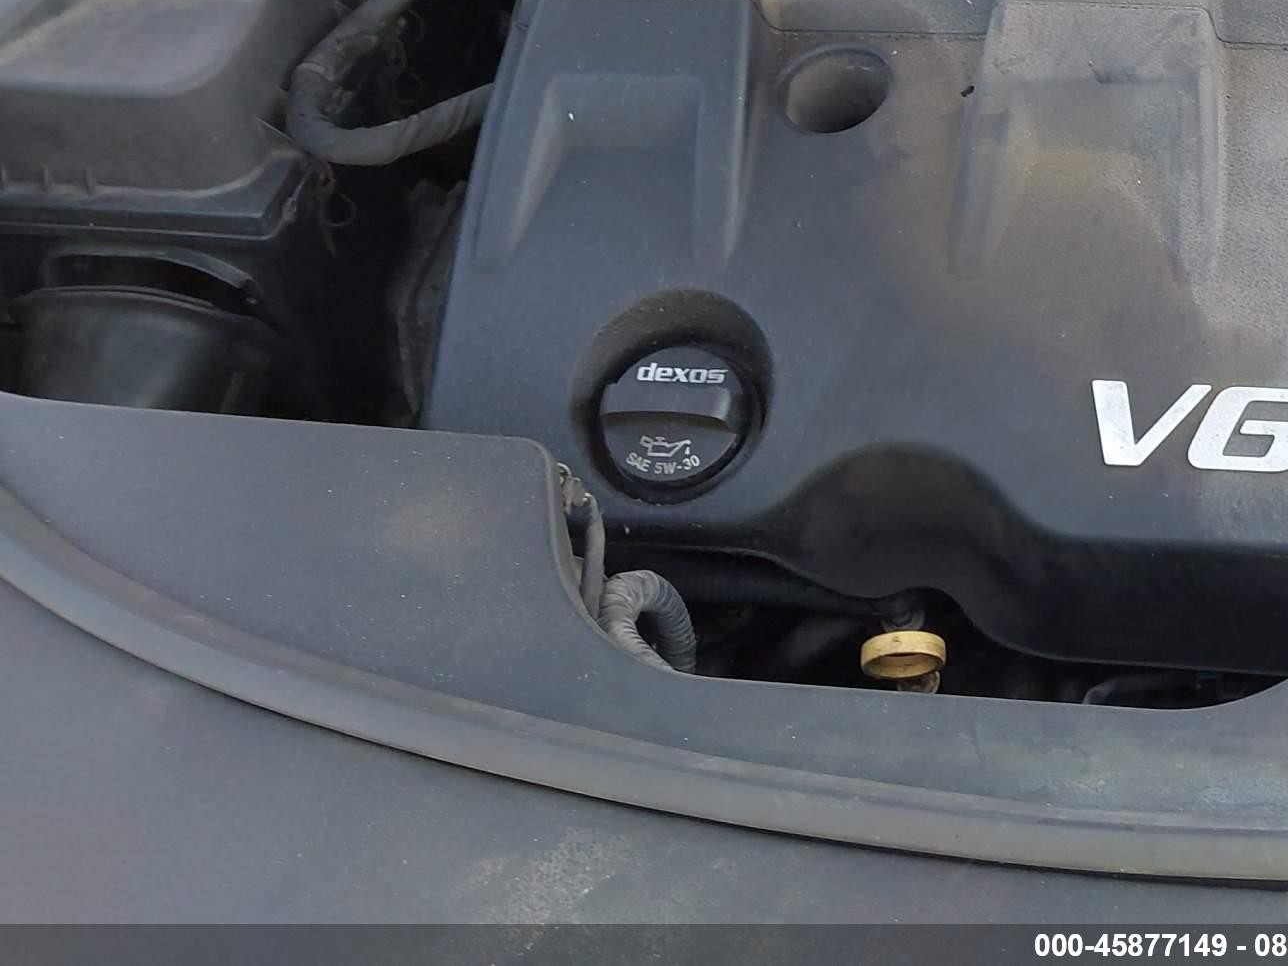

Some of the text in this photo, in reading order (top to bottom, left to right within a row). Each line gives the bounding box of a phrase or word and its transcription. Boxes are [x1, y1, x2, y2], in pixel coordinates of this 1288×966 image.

[636, 362, 728, 384] dexos
[625, 452, 701, 475] SAE 5W-30
